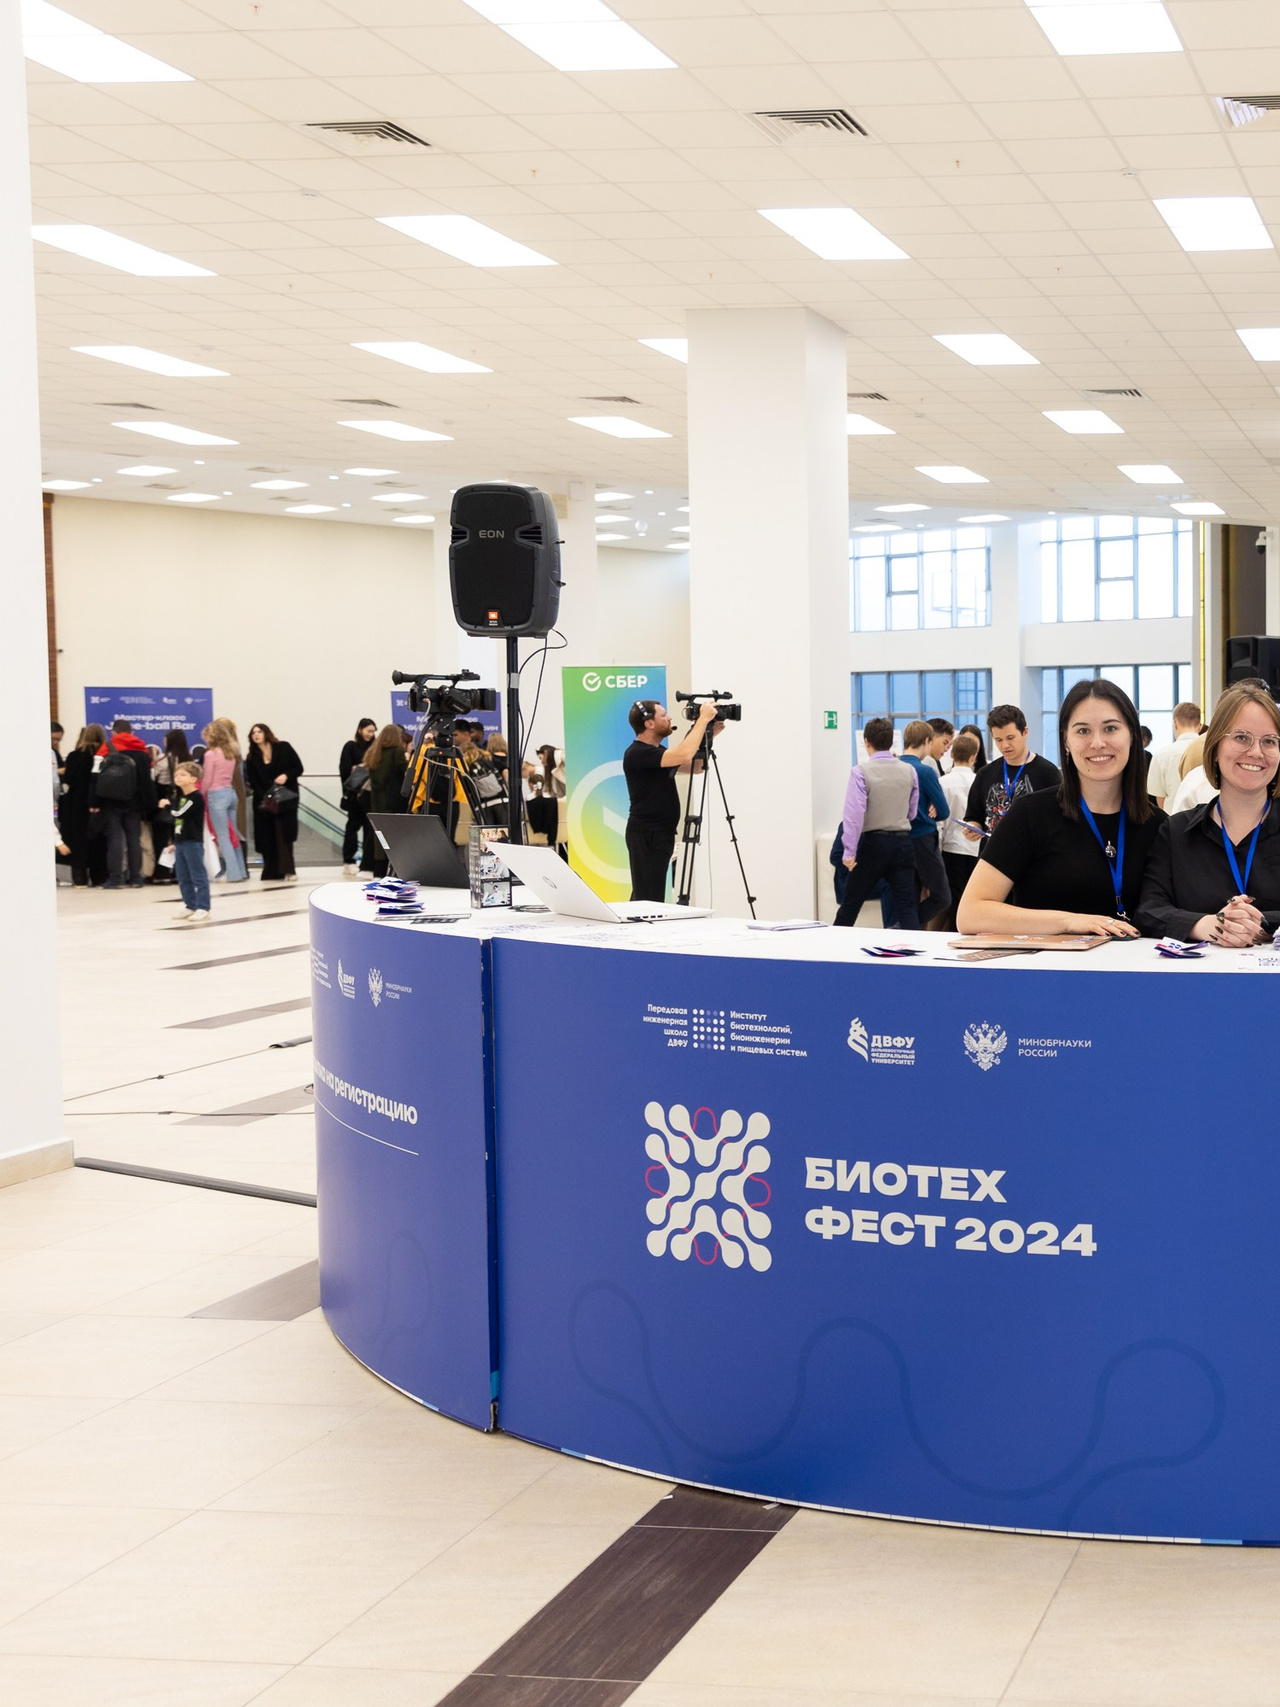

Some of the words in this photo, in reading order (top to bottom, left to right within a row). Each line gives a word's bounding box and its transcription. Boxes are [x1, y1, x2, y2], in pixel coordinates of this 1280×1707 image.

[479, 530, 505, 539] EON
[605, 675, 648, 688] СБЕР
[647, 1003, 688, 1015] Передовая
[642, 1016, 688, 1026] инженерная
[730, 1010, 767, 1022] Институт
[663, 1028, 688, 1037] школа
[730, 1021, 793, 1034] биотехнологий,
[667, 1038, 688, 1048] ДВФУ
[730, 1032, 791, 1046] биоинженерии
[871, 1035, 915, 1049] ДВФУ
[1018, 1038, 1092, 1047] МИНОБРНАУКИ
[737, 1045, 774, 1055] пищевых
[775, 1048, 808, 1057] систем
[1018, 1049, 1058, 1057] РОССИИ
[334, 1076, 418, 1125] регистрацию
[804, 1156, 1007, 1203] БИОТЕХ
[805, 1205, 946, 1248] ФЕСТ
[954, 1217, 1097, 1257] 2024
